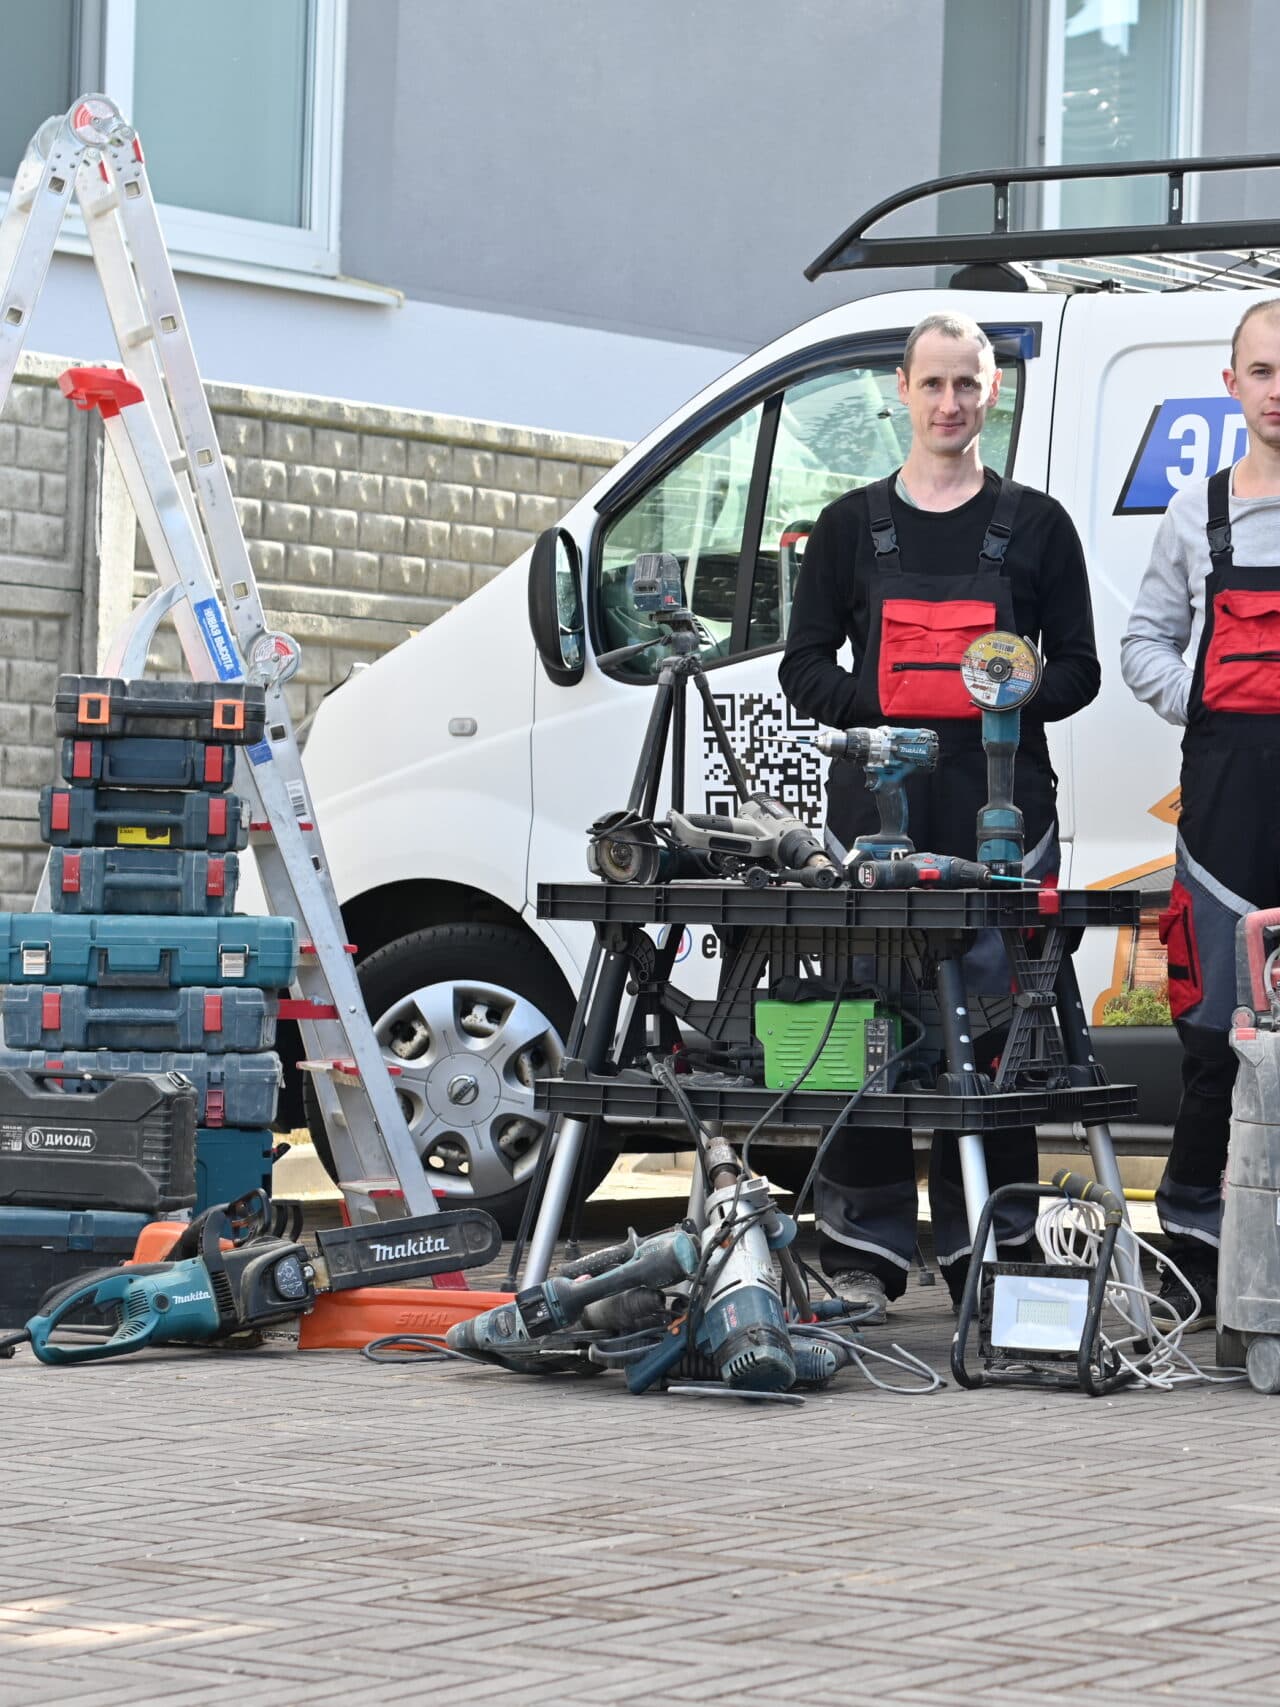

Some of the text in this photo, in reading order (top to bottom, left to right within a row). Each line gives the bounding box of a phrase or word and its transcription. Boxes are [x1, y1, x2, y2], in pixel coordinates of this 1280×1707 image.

[45, 1133, 91, 1147] ДИОЛД
[369, 1236, 450, 1262] makita
[172, 1290, 212, 1305] makita
[395, 1311, 452, 1326] STIHL
